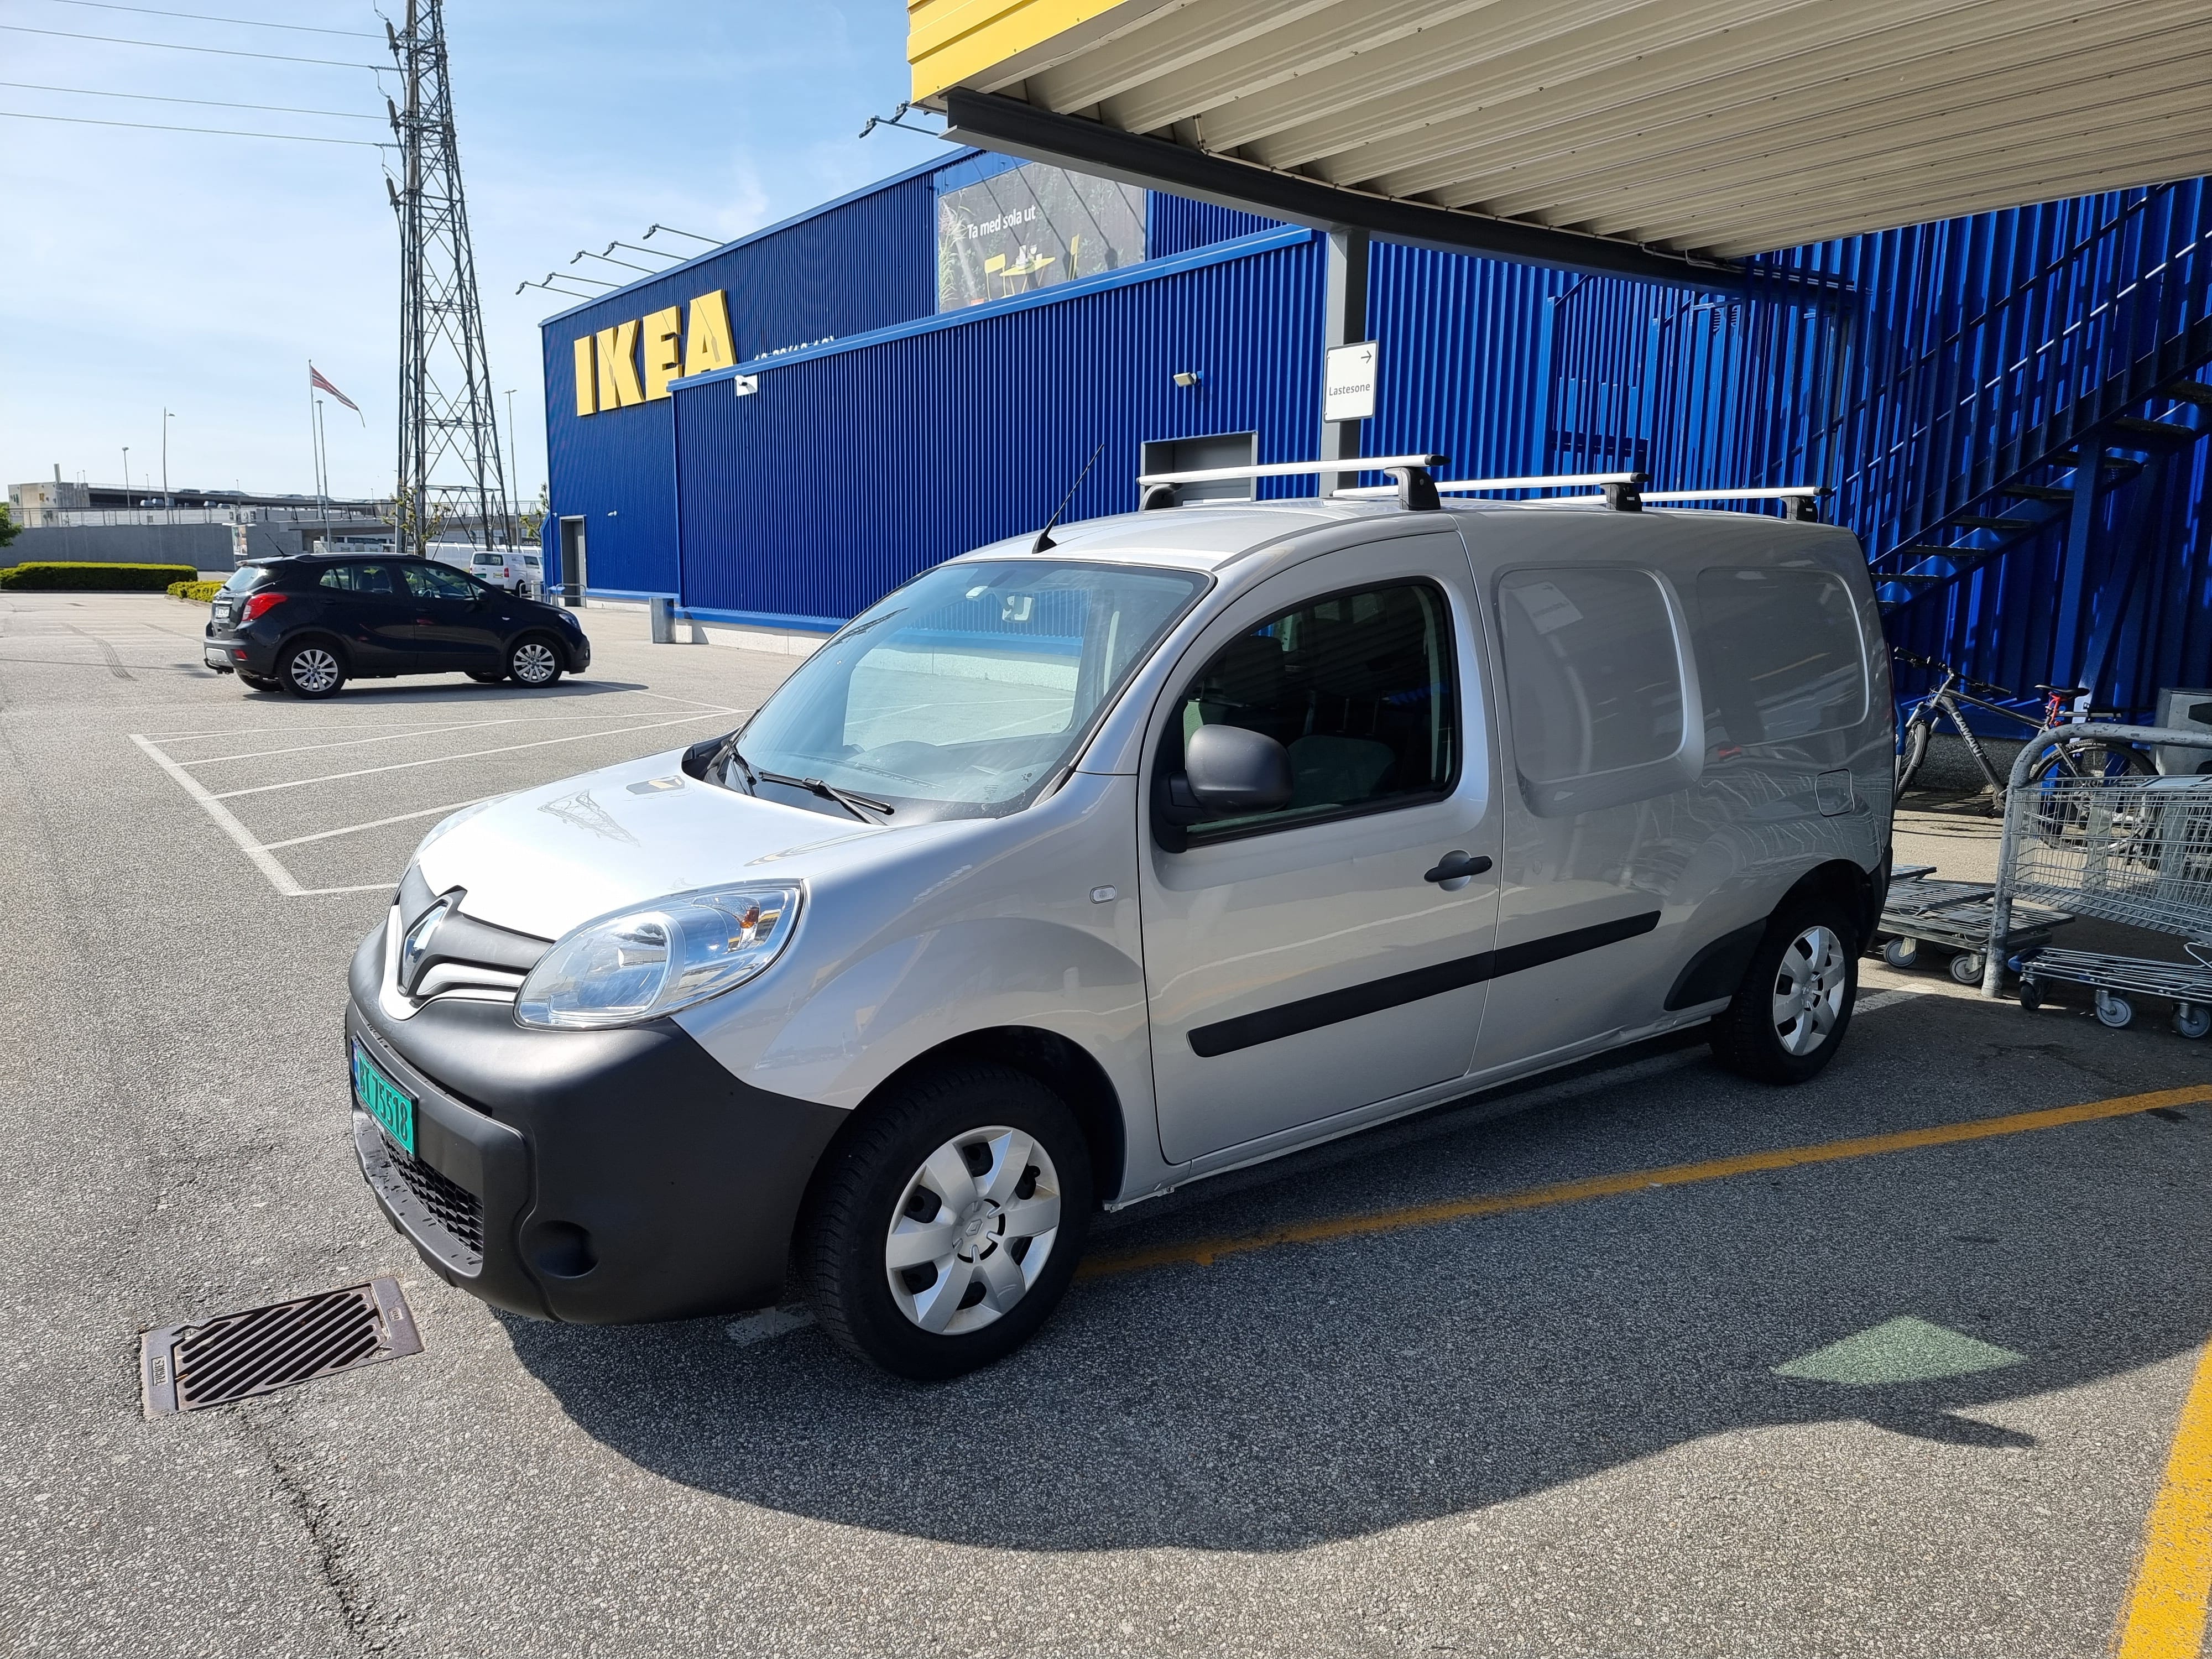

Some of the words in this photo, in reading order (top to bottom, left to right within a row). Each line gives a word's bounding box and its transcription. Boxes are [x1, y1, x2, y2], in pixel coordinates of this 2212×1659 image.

[967, 223, 978, 239] Ta
[980, 213, 1001, 236] med
[1003, 207, 1022, 229] sola
[1024, 204, 1036, 222] ut
[573, 289, 737, 417] IKEA
[1329, 383, 1370, 396] Lastesone
[1952, 711, 1983, 758] DIAMANT
[372, 1073, 408, 1142] 75518
[154, 1359, 166, 1385] FURNES
